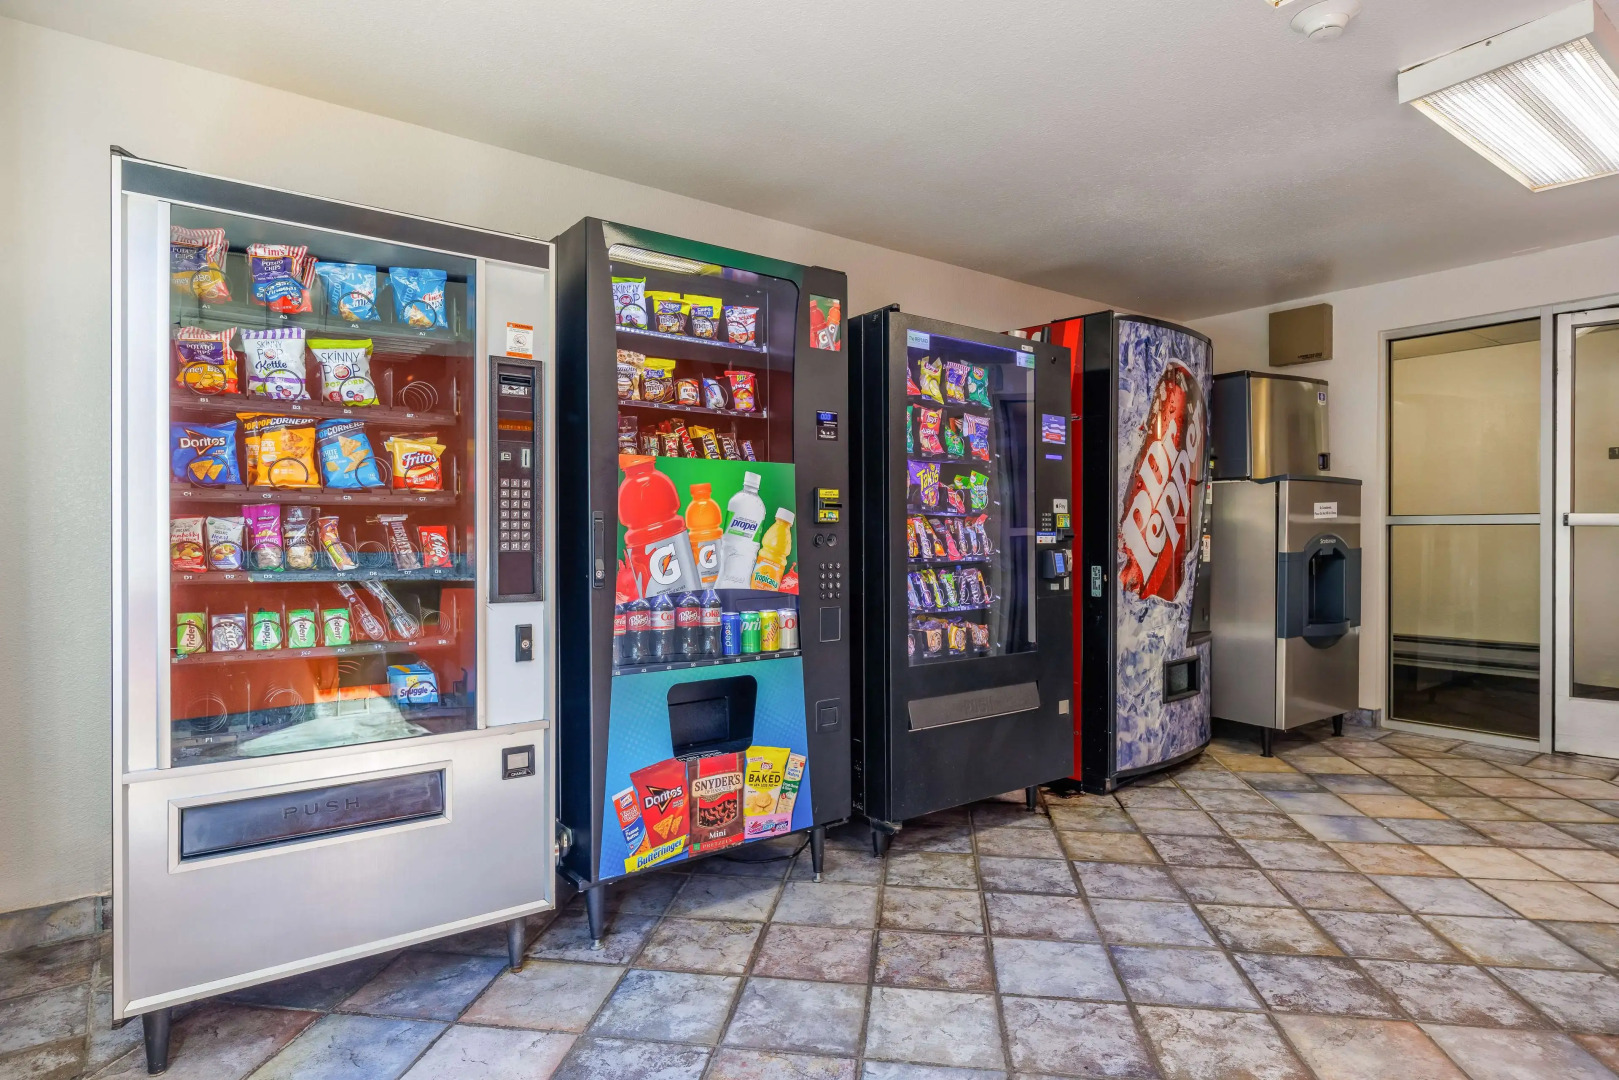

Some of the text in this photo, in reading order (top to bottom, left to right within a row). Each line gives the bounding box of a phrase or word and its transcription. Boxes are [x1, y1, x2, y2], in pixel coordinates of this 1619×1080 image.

[262, 246, 285, 256] Tim's
[261, 259, 284, 267] POTATO
[422, 290, 444, 301] Chex
[829, 323, 836, 333] G
[257, 341, 283, 349] SKINNY
[819, 331, 828, 344] G
[257, 348, 284, 361] POP
[321, 351, 360, 364] SKINNY
[255, 360, 288, 373] Kettle
[322, 363, 361, 381] POP
[325, 379, 365, 388] POPCORN
[258, 417, 315, 430] POPCORNERS
[180, 436, 226, 449] Doritos
[402, 450, 437, 469] Fritos
[1138, 418, 1179, 500] Dr
[917, 469, 940, 492] Takis
[1121, 398, 1200, 588] Pepper
[731, 518, 759, 532] propel
[649, 543, 682, 585] G
[699, 543, 717, 569] G
[753, 571, 779, 589] Tropicana
[262, 619, 272, 646] Trident
[299, 615, 308, 642] Trident
[333, 613, 342, 640] Trident
[740, 617, 761, 634] prit
[187, 619, 196, 650] Trident
[725, 622, 733, 648] pepsi
[400, 686, 428, 698] Snuggle
[694, 773, 742, 793] SNYDER'S
[748, 773, 782, 785] BAKED
[644, 786, 684, 810] Doritos
[282, 797, 361, 820] PUSH
[709, 829, 726, 840] Mini
[702, 838, 733, 850] PRETZELS
[636, 838, 683, 869] Butterfinger
